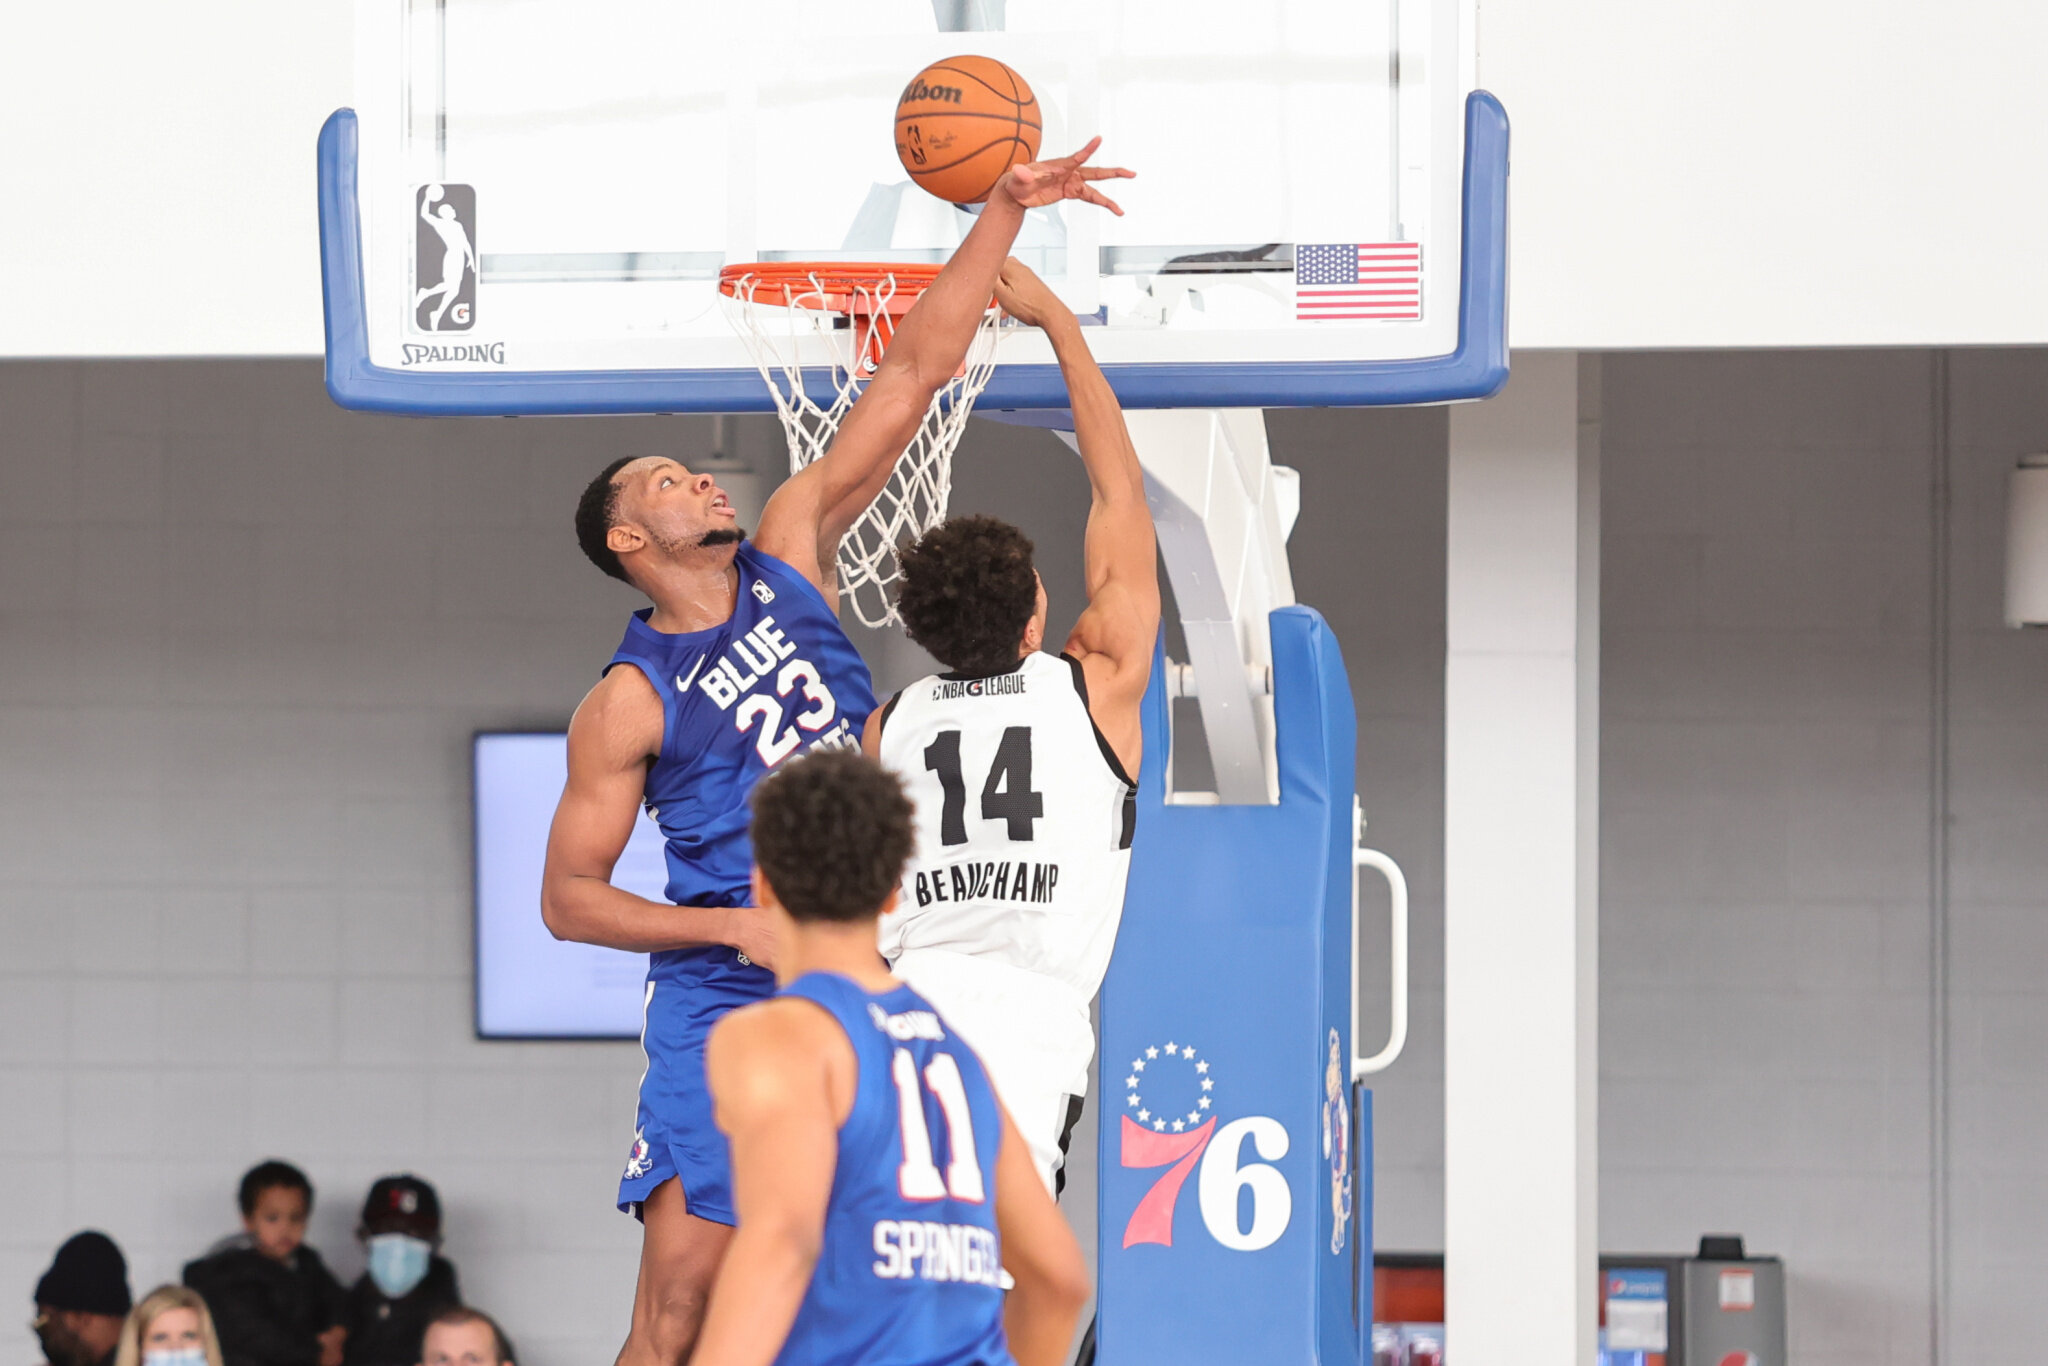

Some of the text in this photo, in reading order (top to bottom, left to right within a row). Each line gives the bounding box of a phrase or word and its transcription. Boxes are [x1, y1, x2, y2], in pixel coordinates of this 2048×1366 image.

[901, 79, 963, 104] ilson
[401, 342, 505, 366] SPALDING
[698, 615, 798, 711] BLUE
[942, 674, 1026, 700] NBA G LEAGUE
[736, 659, 836, 768] 23
[924, 726, 1043, 846] 14
[916, 862, 1059, 908] BEAUCHAMP
[892, 1047, 986, 1205] 11
[1121, 1113, 1292, 1251] 76
